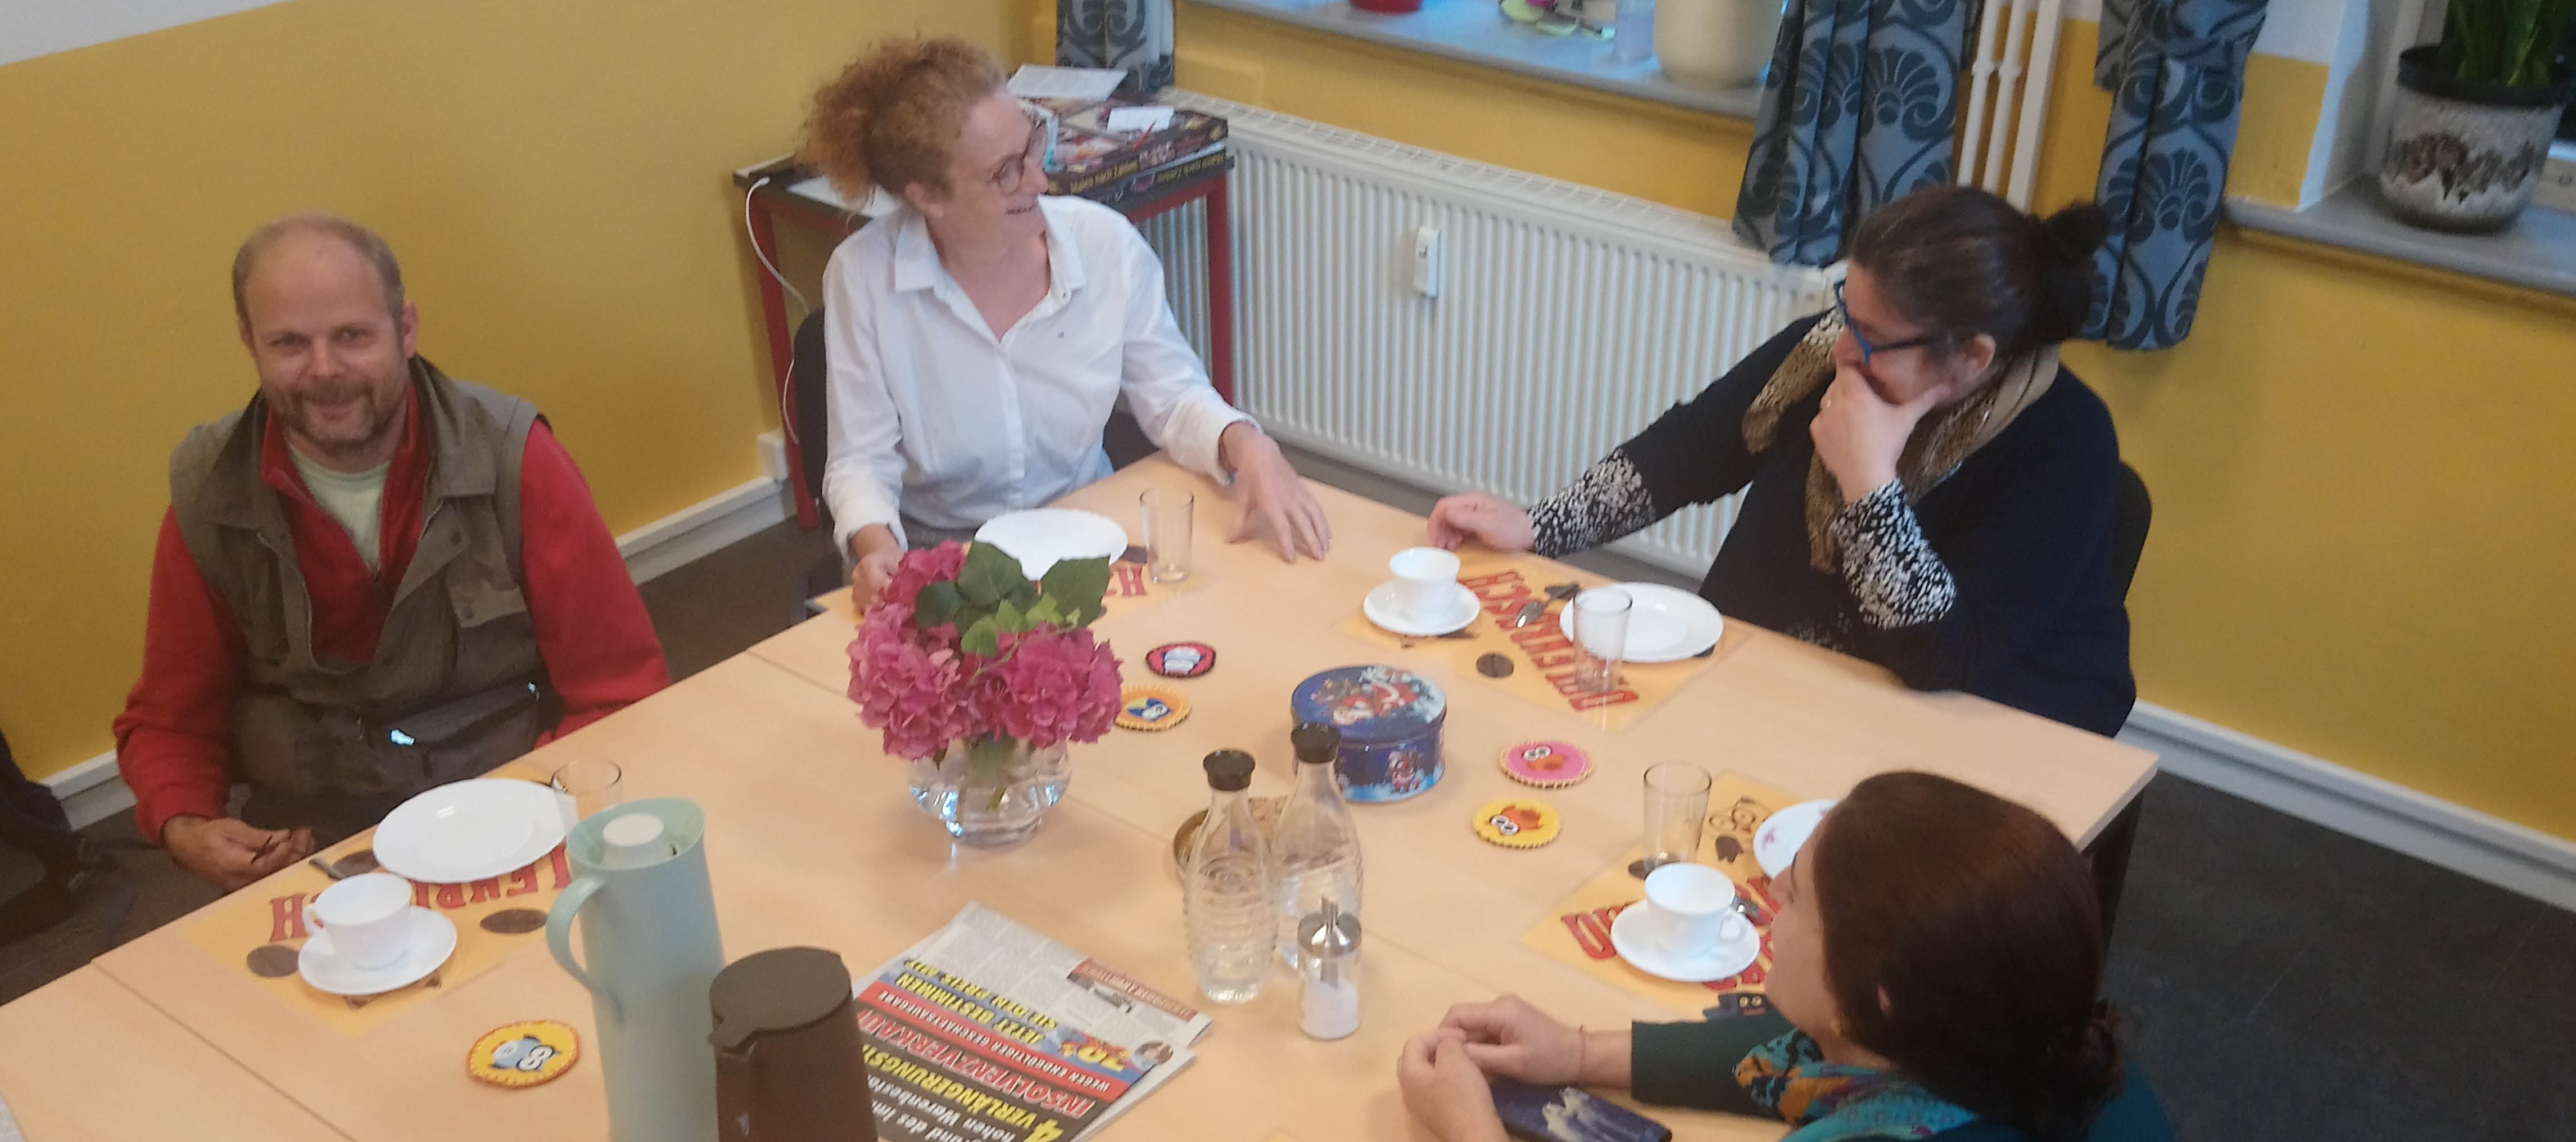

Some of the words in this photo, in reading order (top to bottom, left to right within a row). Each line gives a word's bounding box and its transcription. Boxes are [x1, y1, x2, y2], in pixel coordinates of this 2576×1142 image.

[894, 971, 995, 1026] BESTIMMEN
[877, 989, 990, 1046] GESCHÄFTSAUFGABE
[993, 1018, 1045, 1045] JETZT
[990, 1041, 1069, 1078] ENDGÜLTIGER
[862, 1043, 1038, 1130] VERLÄNGERUNGST
[867, 1073, 961, 1126] Warenbesta
[1069, 1071, 1111, 1093] WEGEN
[896, 1113, 927, 1134] des
[1022, 1118, 1063, 1142] 4
